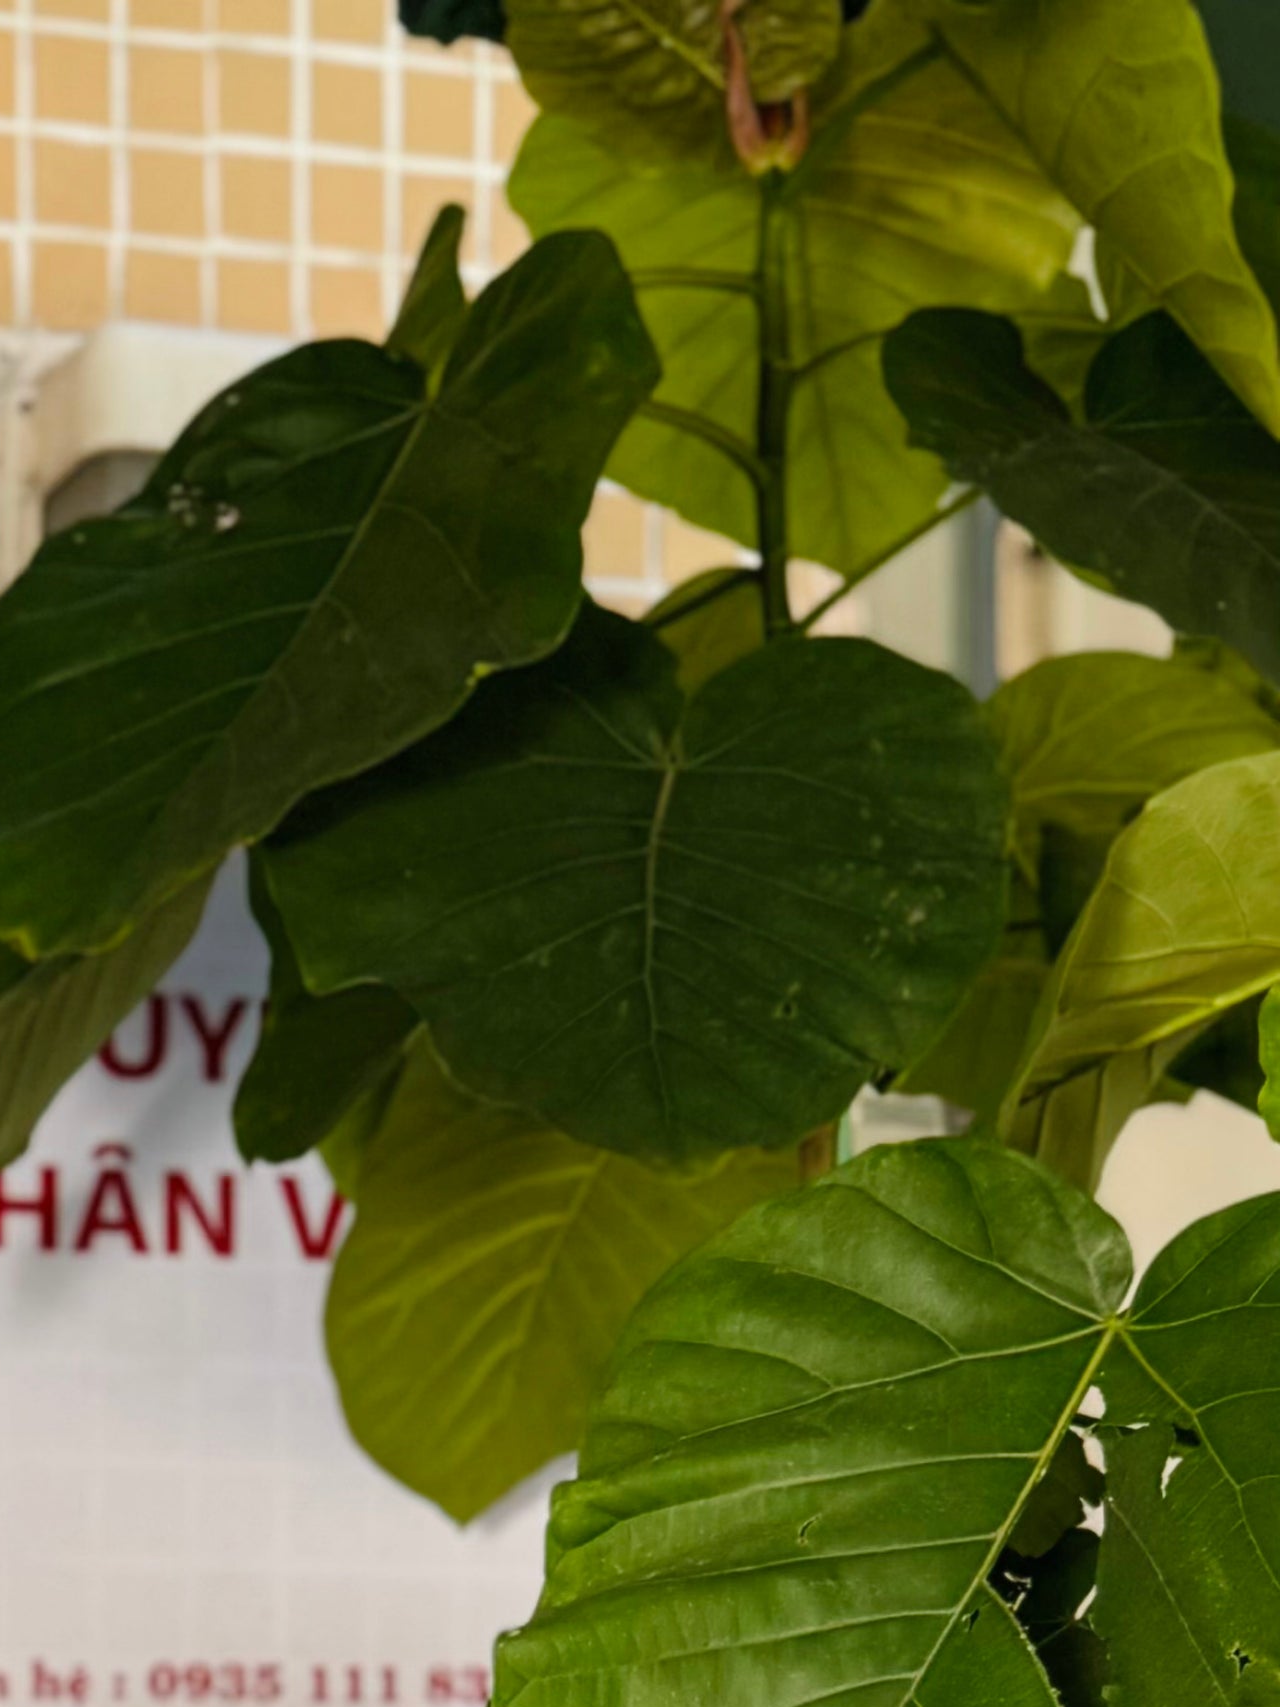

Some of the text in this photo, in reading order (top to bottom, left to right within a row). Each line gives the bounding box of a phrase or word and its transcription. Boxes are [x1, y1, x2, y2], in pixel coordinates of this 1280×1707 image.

[147, 1662, 283, 1702] 0935
[310, 1664, 398, 1703] 111
[426, 1664, 489, 1706] 83
